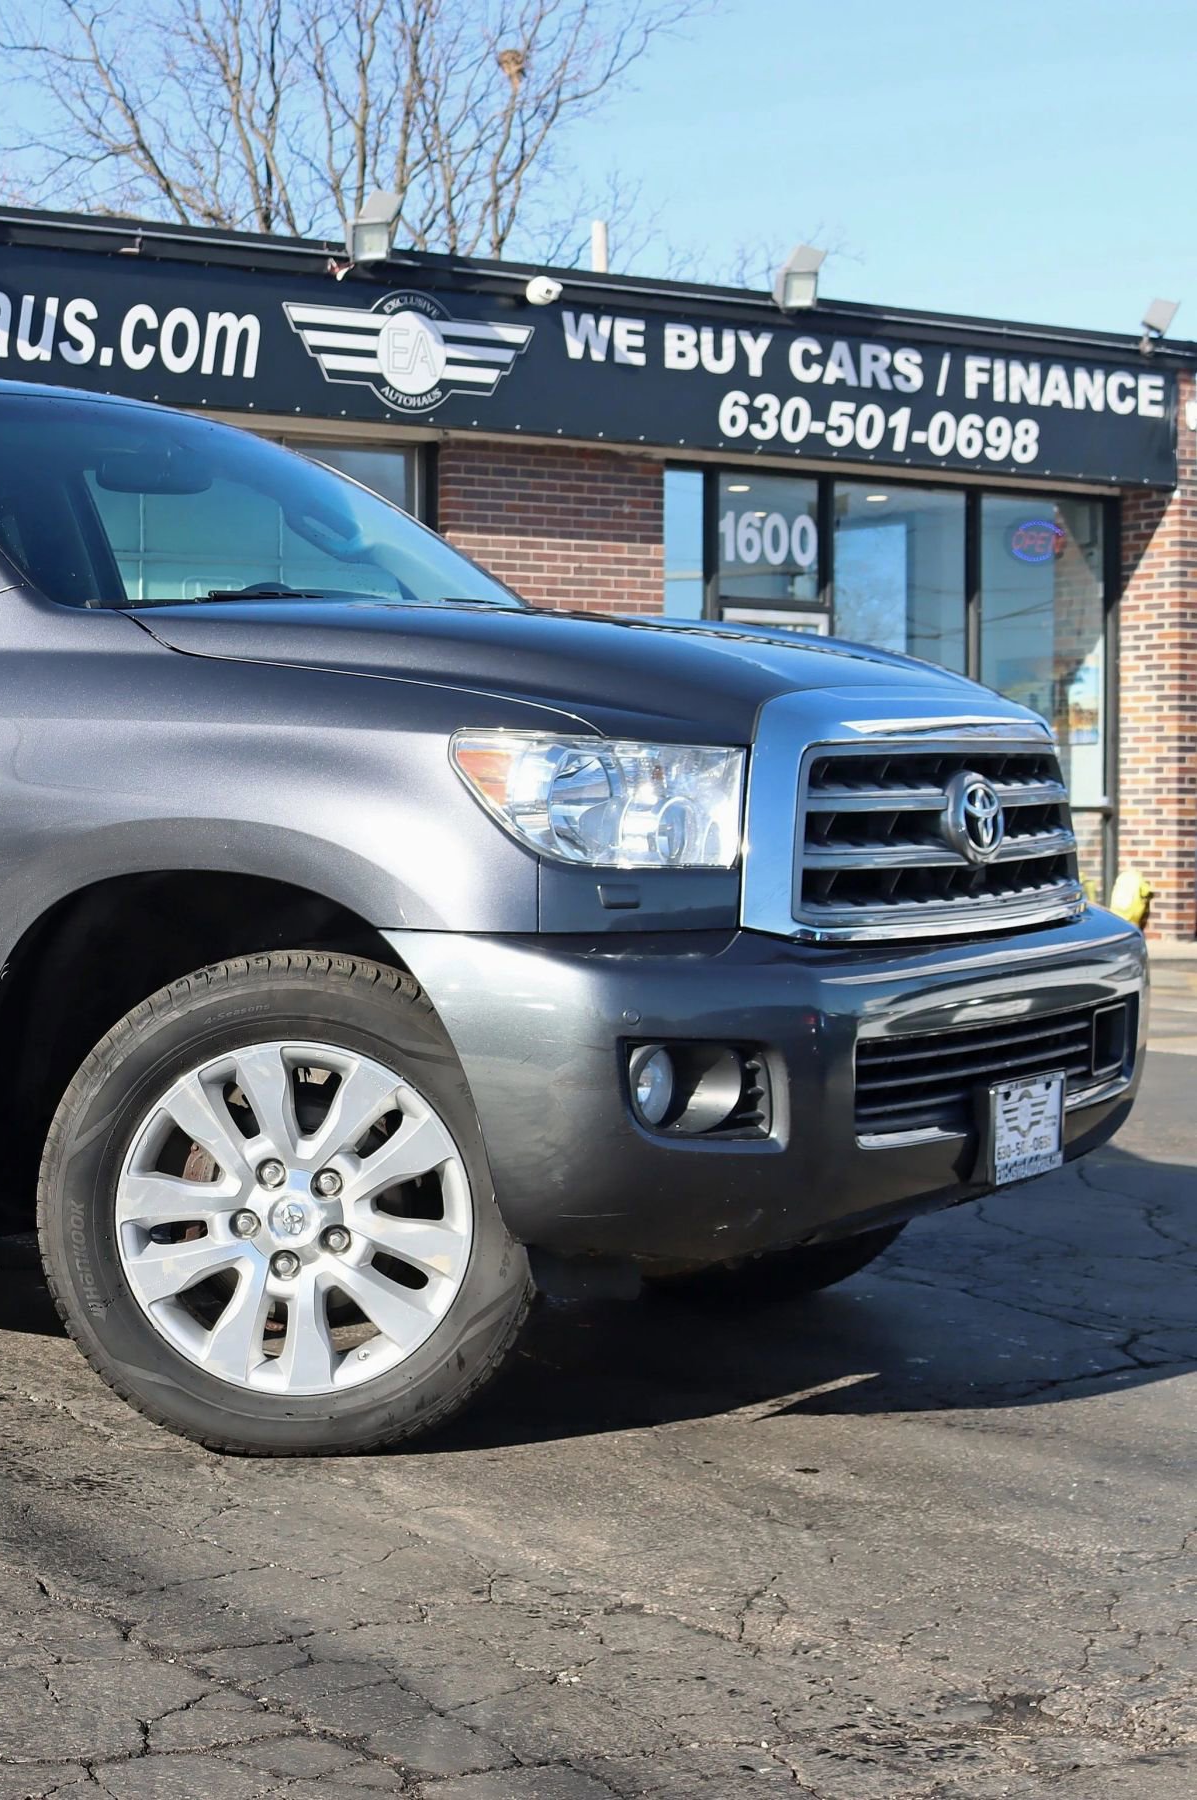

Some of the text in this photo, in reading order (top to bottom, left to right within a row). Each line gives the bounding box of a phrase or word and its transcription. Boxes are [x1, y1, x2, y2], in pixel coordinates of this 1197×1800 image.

[383, 296, 440, 319] EXCLUSIVE
[387, 327, 437, 377] EA
[562, 310, 1165, 418] WE BUY CARS / FINANCE
[380, 385, 443, 407] AUTOHAUS
[718, 390, 1039, 464] 630-501-0698
[719, 510, 817, 567] 1600
[1012, 529, 1065, 555] OPEN
